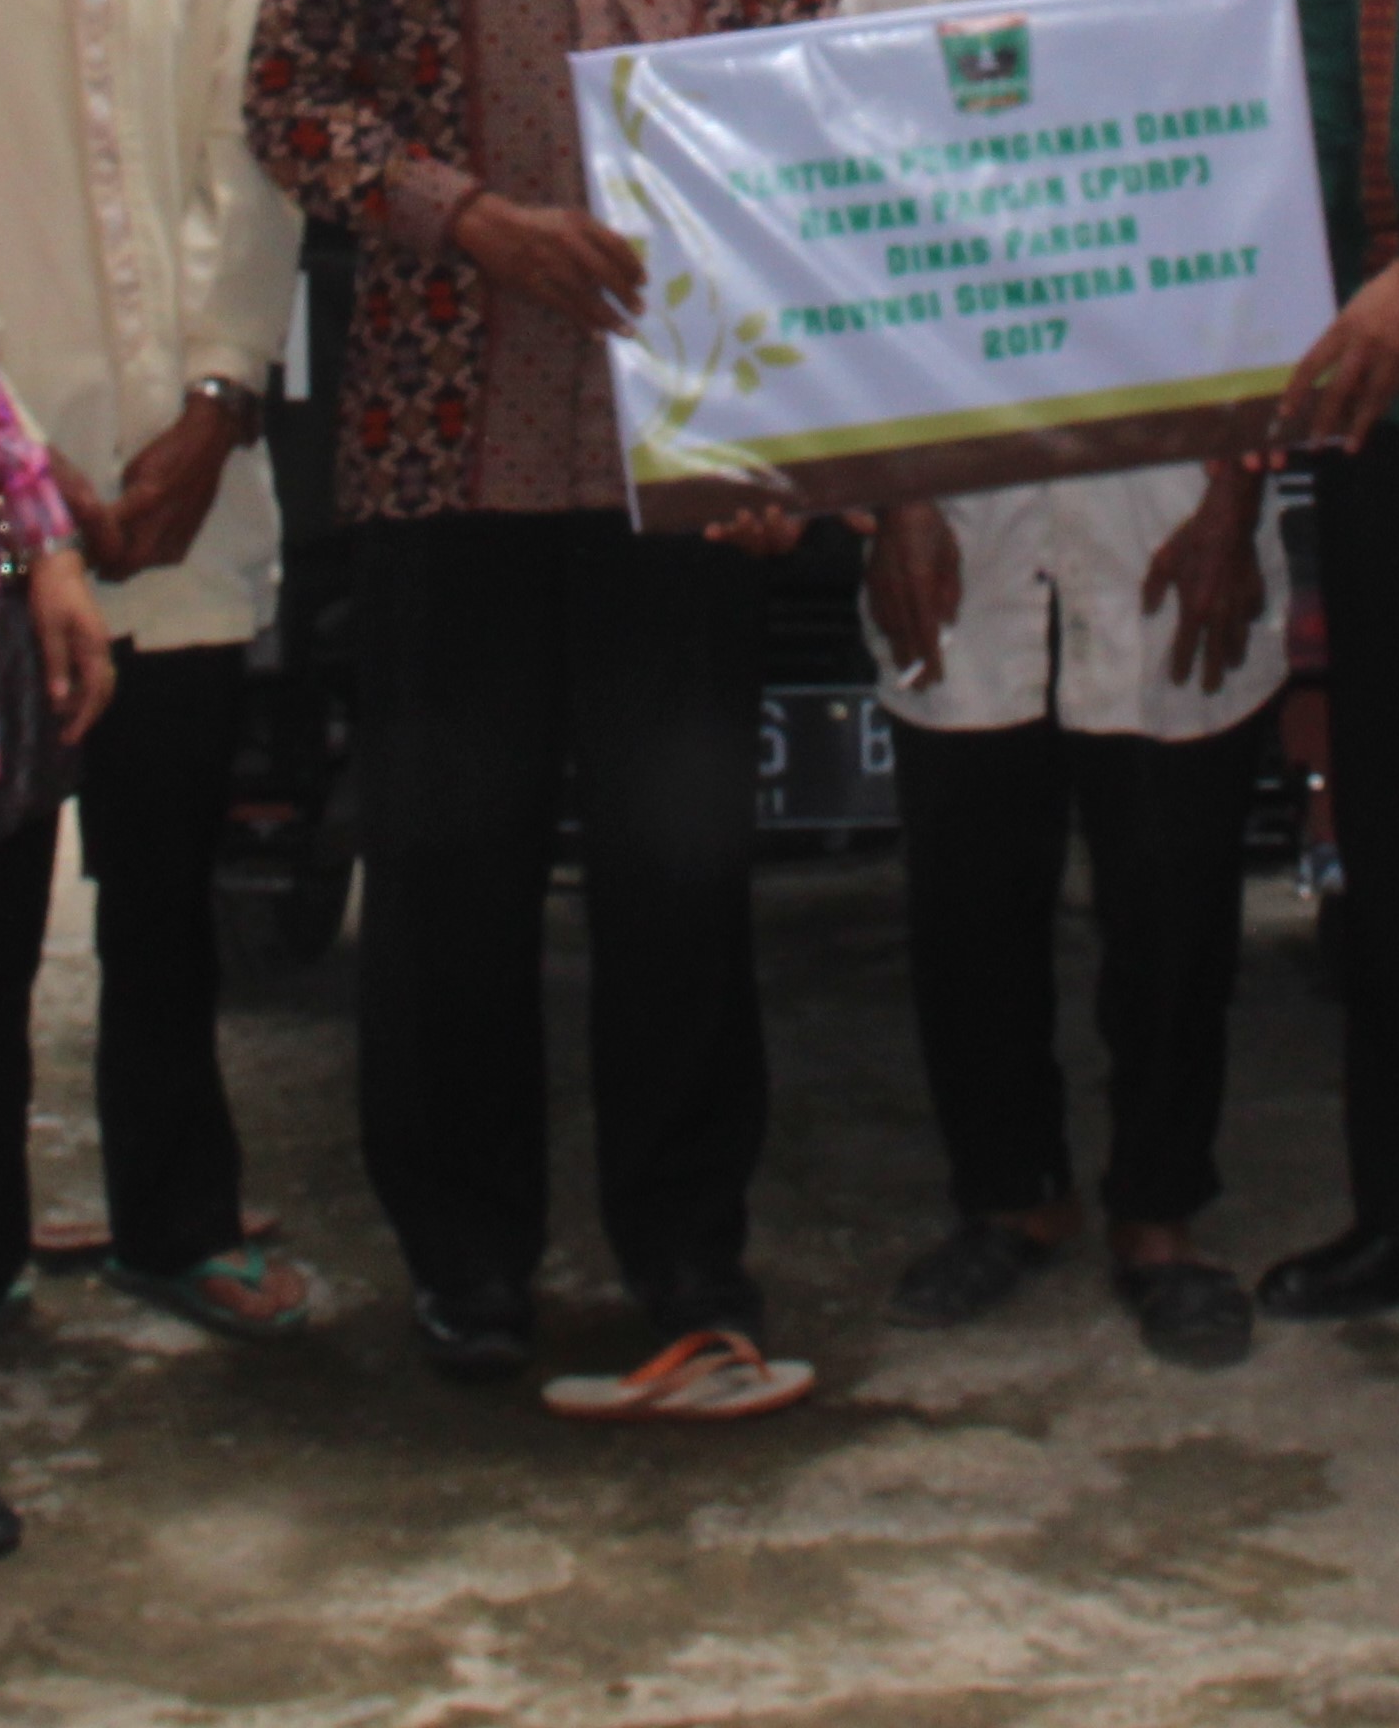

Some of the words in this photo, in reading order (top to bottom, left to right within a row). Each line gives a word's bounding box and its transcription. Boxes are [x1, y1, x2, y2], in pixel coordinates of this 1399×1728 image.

[1134, 98, 1268, 145] DAERAH
[932, 174, 1066, 222] PANGAN
[886, 236, 991, 278] DINAS
[1003, 215, 1138, 262] PANGAN
[955, 264, 1135, 315] SUMATERA
[1148, 244, 1259, 291] BARAT
[982, 318, 1068, 360] 2017
